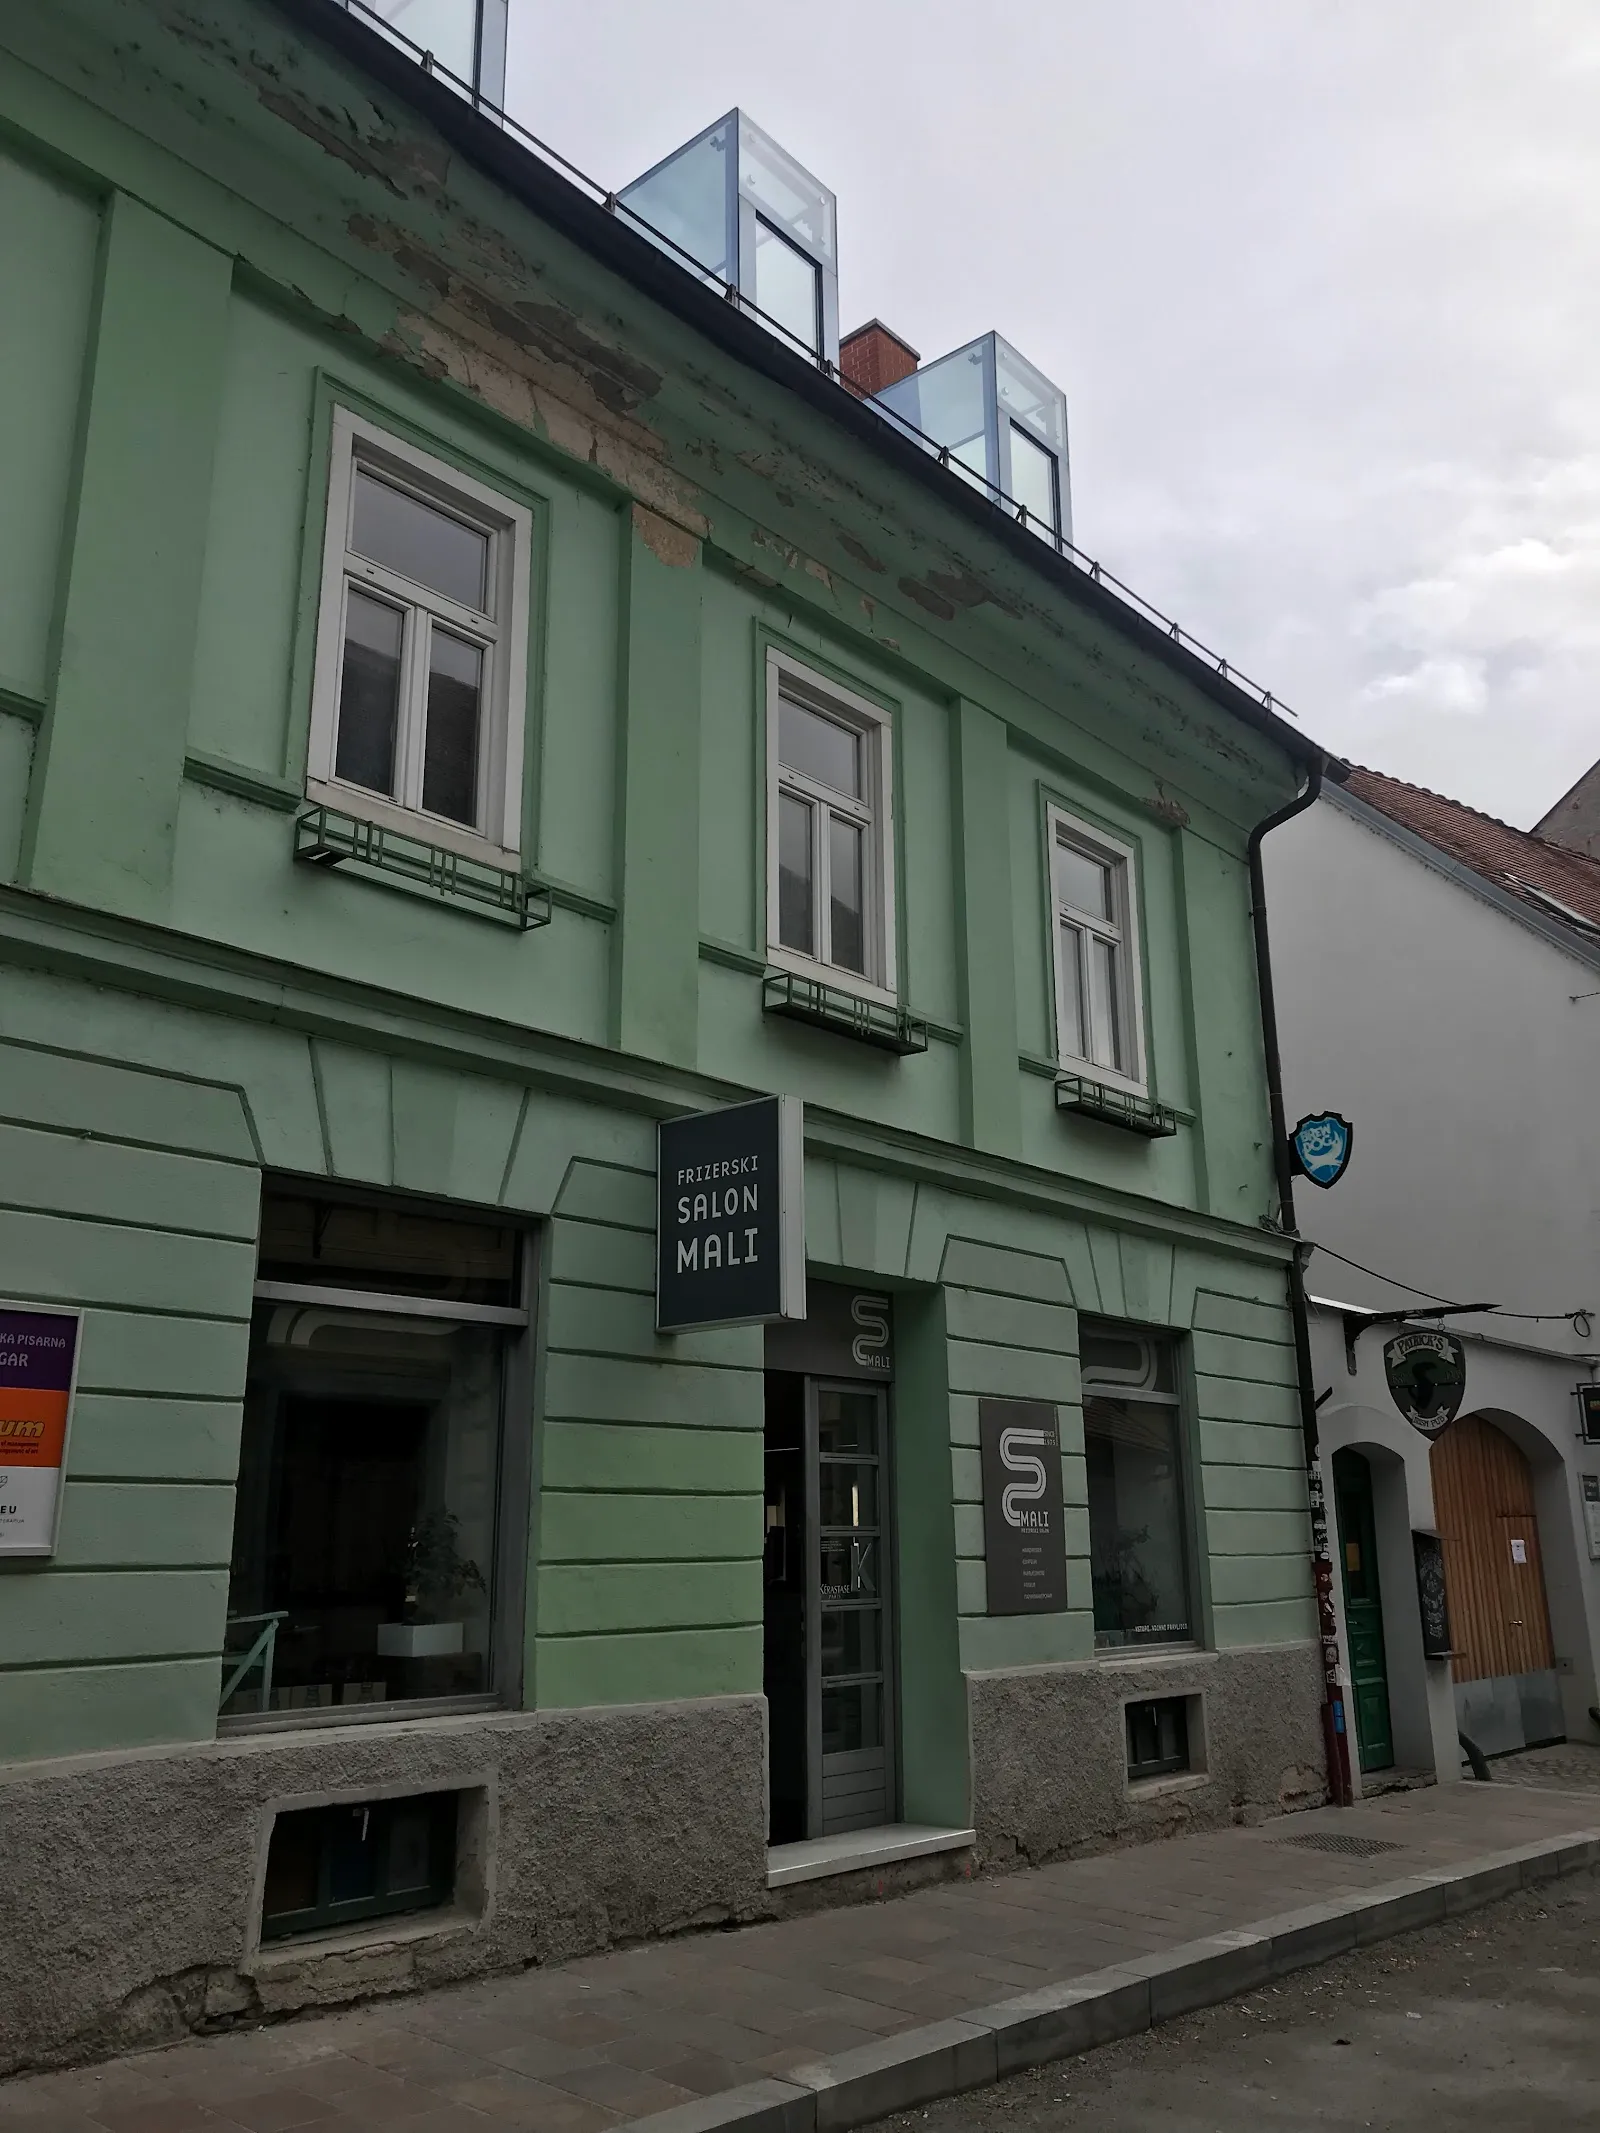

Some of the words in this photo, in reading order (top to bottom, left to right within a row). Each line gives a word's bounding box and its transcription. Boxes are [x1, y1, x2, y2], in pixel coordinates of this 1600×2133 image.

[1300, 1123, 1331, 1142] BREW
[1303, 1134, 1334, 1153] DOG
[677, 1155, 759, 1186] FRIZERSKI
[677, 1183, 759, 1224] SALON
[676, 1227, 759, 1274] MALI
[17, 1334, 66, 1349] PISARNA
[1397, 1334, 1444, 1354] PATRICK'S
[867, 1354, 891, 1368] MALI
[1431, 1415, 1446, 1428] PUB
[1020, 1510, 1049, 1527] MALI
